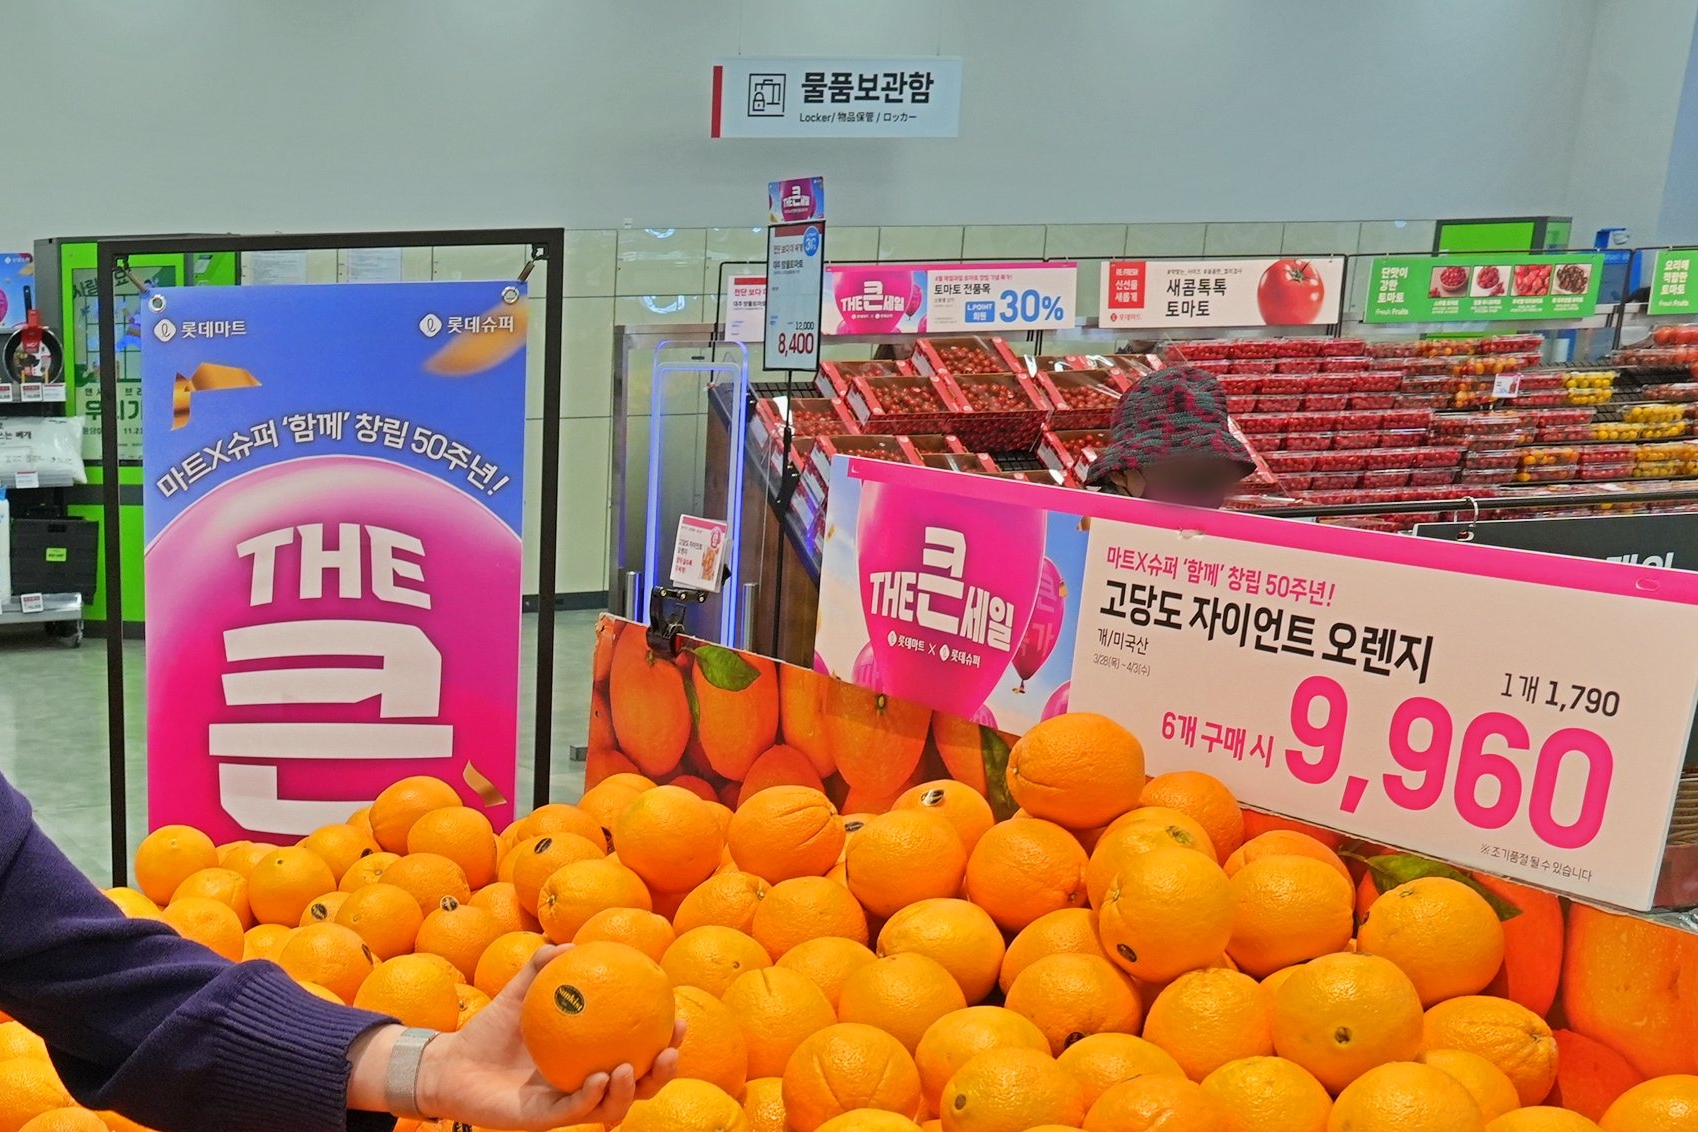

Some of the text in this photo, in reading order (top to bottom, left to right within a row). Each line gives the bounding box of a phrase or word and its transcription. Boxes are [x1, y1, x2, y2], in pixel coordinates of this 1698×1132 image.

[801, 72, 934, 104] 물품보관함
[837, 112, 874, 123] 物品保管
[883, 112, 917, 123] ロッカー
[1115, 279, 1138, 291] 신선을
[1381, 266, 1408, 279] 단맛이
[841, 280, 905, 312] THE 큰 세일
[934, 282, 991, 296] 토마토 전품목
[1114, 291, 1138, 303] 새롭게
[1166, 278, 1227, 297] 새콤톡톡
[1377, 292, 1405, 303] 토마토
[1379, 279, 1398, 292] 강한
[1660, 284, 1686, 295] 토마토
[999, 289, 1064, 323] 30%
[1165, 299, 1210, 317] 토마토
[181, 320, 247, 339] 롯데마트
[446, 315, 515, 334] 롯데슈퍼
[795, 321, 814, 331] 12,000
[778, 332, 814, 357] 8,400
[156, 421, 280, 499] 마트X슈퍼
[355, 412, 409, 448] 창립
[410, 430, 510, 497] 50주년!
[236, 522, 432, 610] THE
[1106, 546, 1179, 580] 마트X슈퍼
[1227, 566, 1262, 595] 창립
[1265, 574, 1336, 607] 50주년!
[870, 571, 917, 622] THE
[916, 526, 967, 635] 큰
[959, 586, 1015, 652] 세일
[1097, 628, 1149, 656] 개/미국산
[1099, 579, 1183, 631] 고당도
[1188, 596, 1316, 658] 자이언트
[1321, 622, 1434, 684] 오렌지
[898, 634, 925, 653] 롯데마트
[951, 648, 982, 668] 롯데슈퍼
[1500, 673, 1620, 717] 1개 1,790
[208, 619, 454, 836] 큰
[1161, 711, 1275, 769] 6개 구매 시
[1284, 675, 1614, 849] 9,960
[1552, 861, 1592, 882] 있습니다
